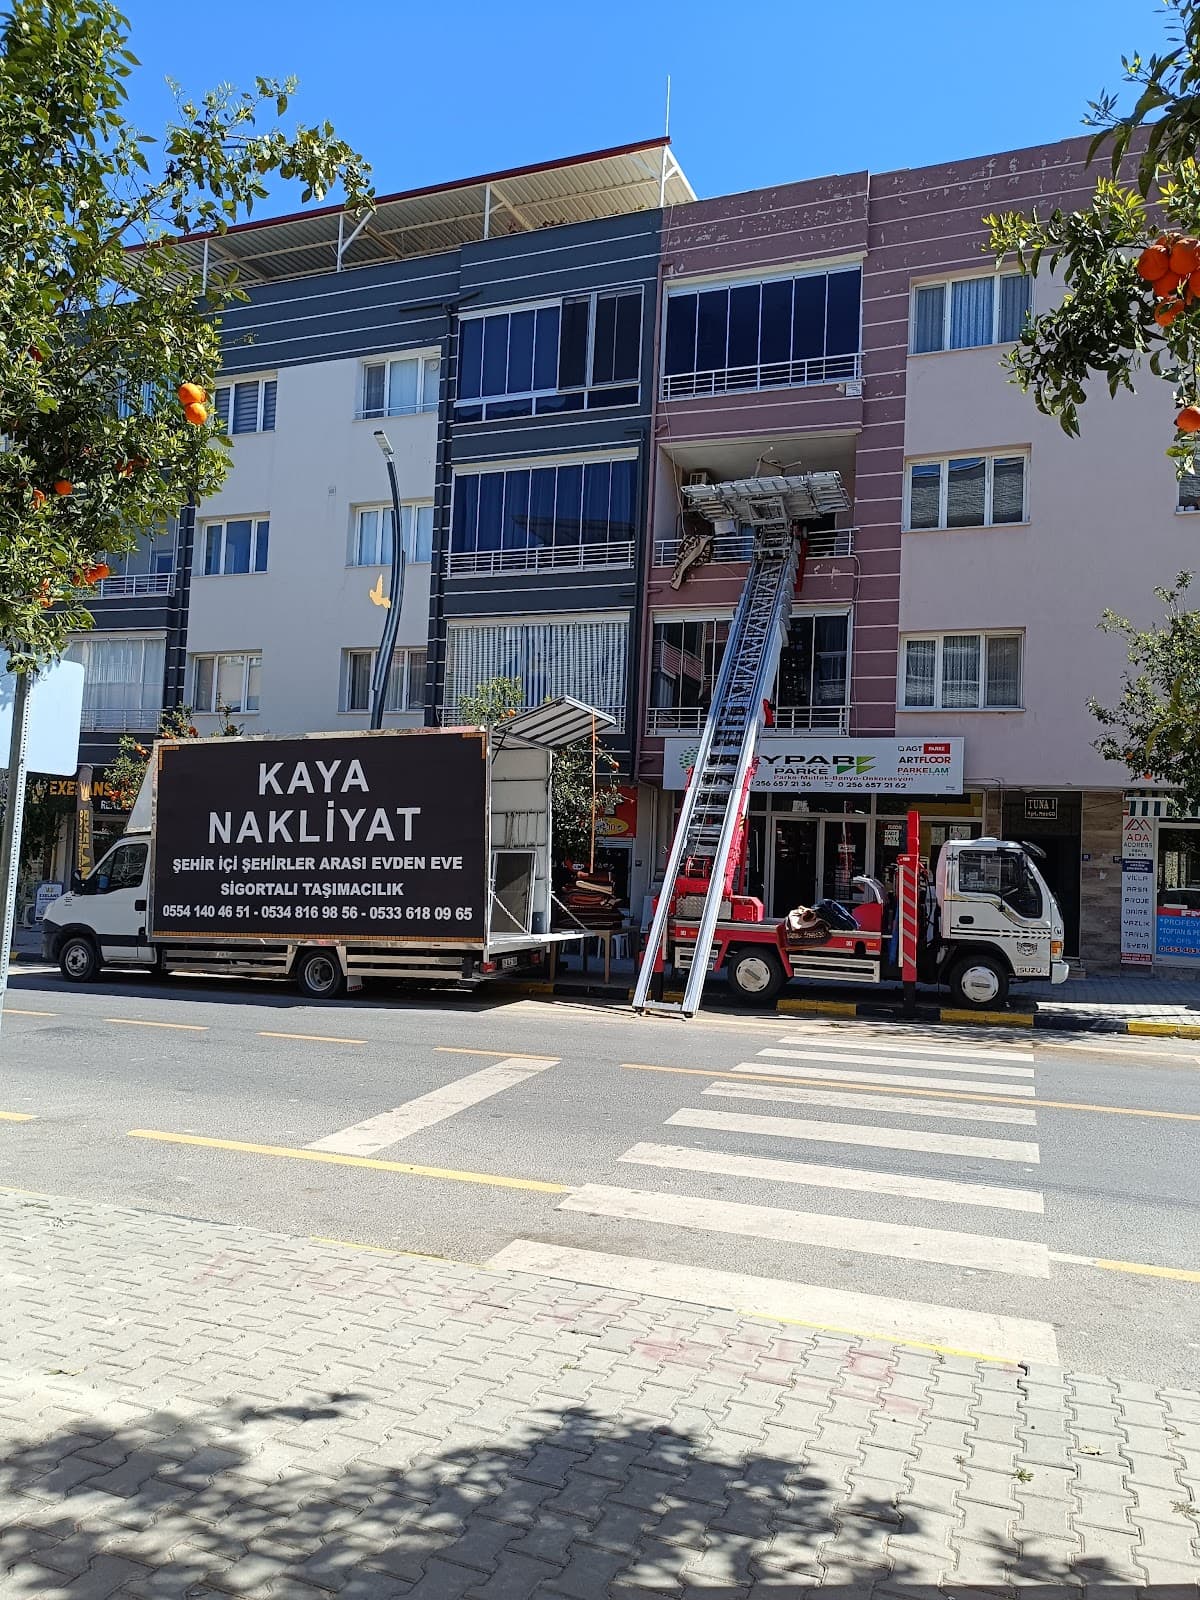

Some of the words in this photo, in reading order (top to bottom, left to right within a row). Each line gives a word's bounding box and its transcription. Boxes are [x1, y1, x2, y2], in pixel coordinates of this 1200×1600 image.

[757, 755, 855, 765] YPAR
[898, 756, 951, 764] ARTFLOOR
[258, 759, 370, 795] KAYA
[49, 781, 112, 796] EXENS
[1027, 799, 1049, 809] TUNA
[208, 801, 421, 844] NAKLİYAT
[1126, 833, 1150, 842] ADA
[172, 856, 215, 874] ŞEHİR
[218, 855, 238, 872] İÇİ
[241, 855, 315, 873] ŞEHİRLER
[319, 856, 367, 870] ARASI
[371, 856, 426, 870] EVDEN
[430, 856, 463, 870] EVE
[220, 882, 298, 897] SİGORTALI
[302, 882, 404, 899] TAŞIMACILIK
[162, 904, 191, 918] 0554
[193, 904, 216, 918] 140
[217, 905, 233, 918] 46
[235, 905, 250, 918] 51
[261, 905, 292, 919] 0534
[295, 905, 319, 919] 816
[321, 906, 338, 919] 98
[341, 906, 358, 919] 56
[369, 906, 402, 920] 0533
[405, 906, 431, 920] 618
[434, 907, 452, 920] 09
[455, 907, 473, 921] 65
